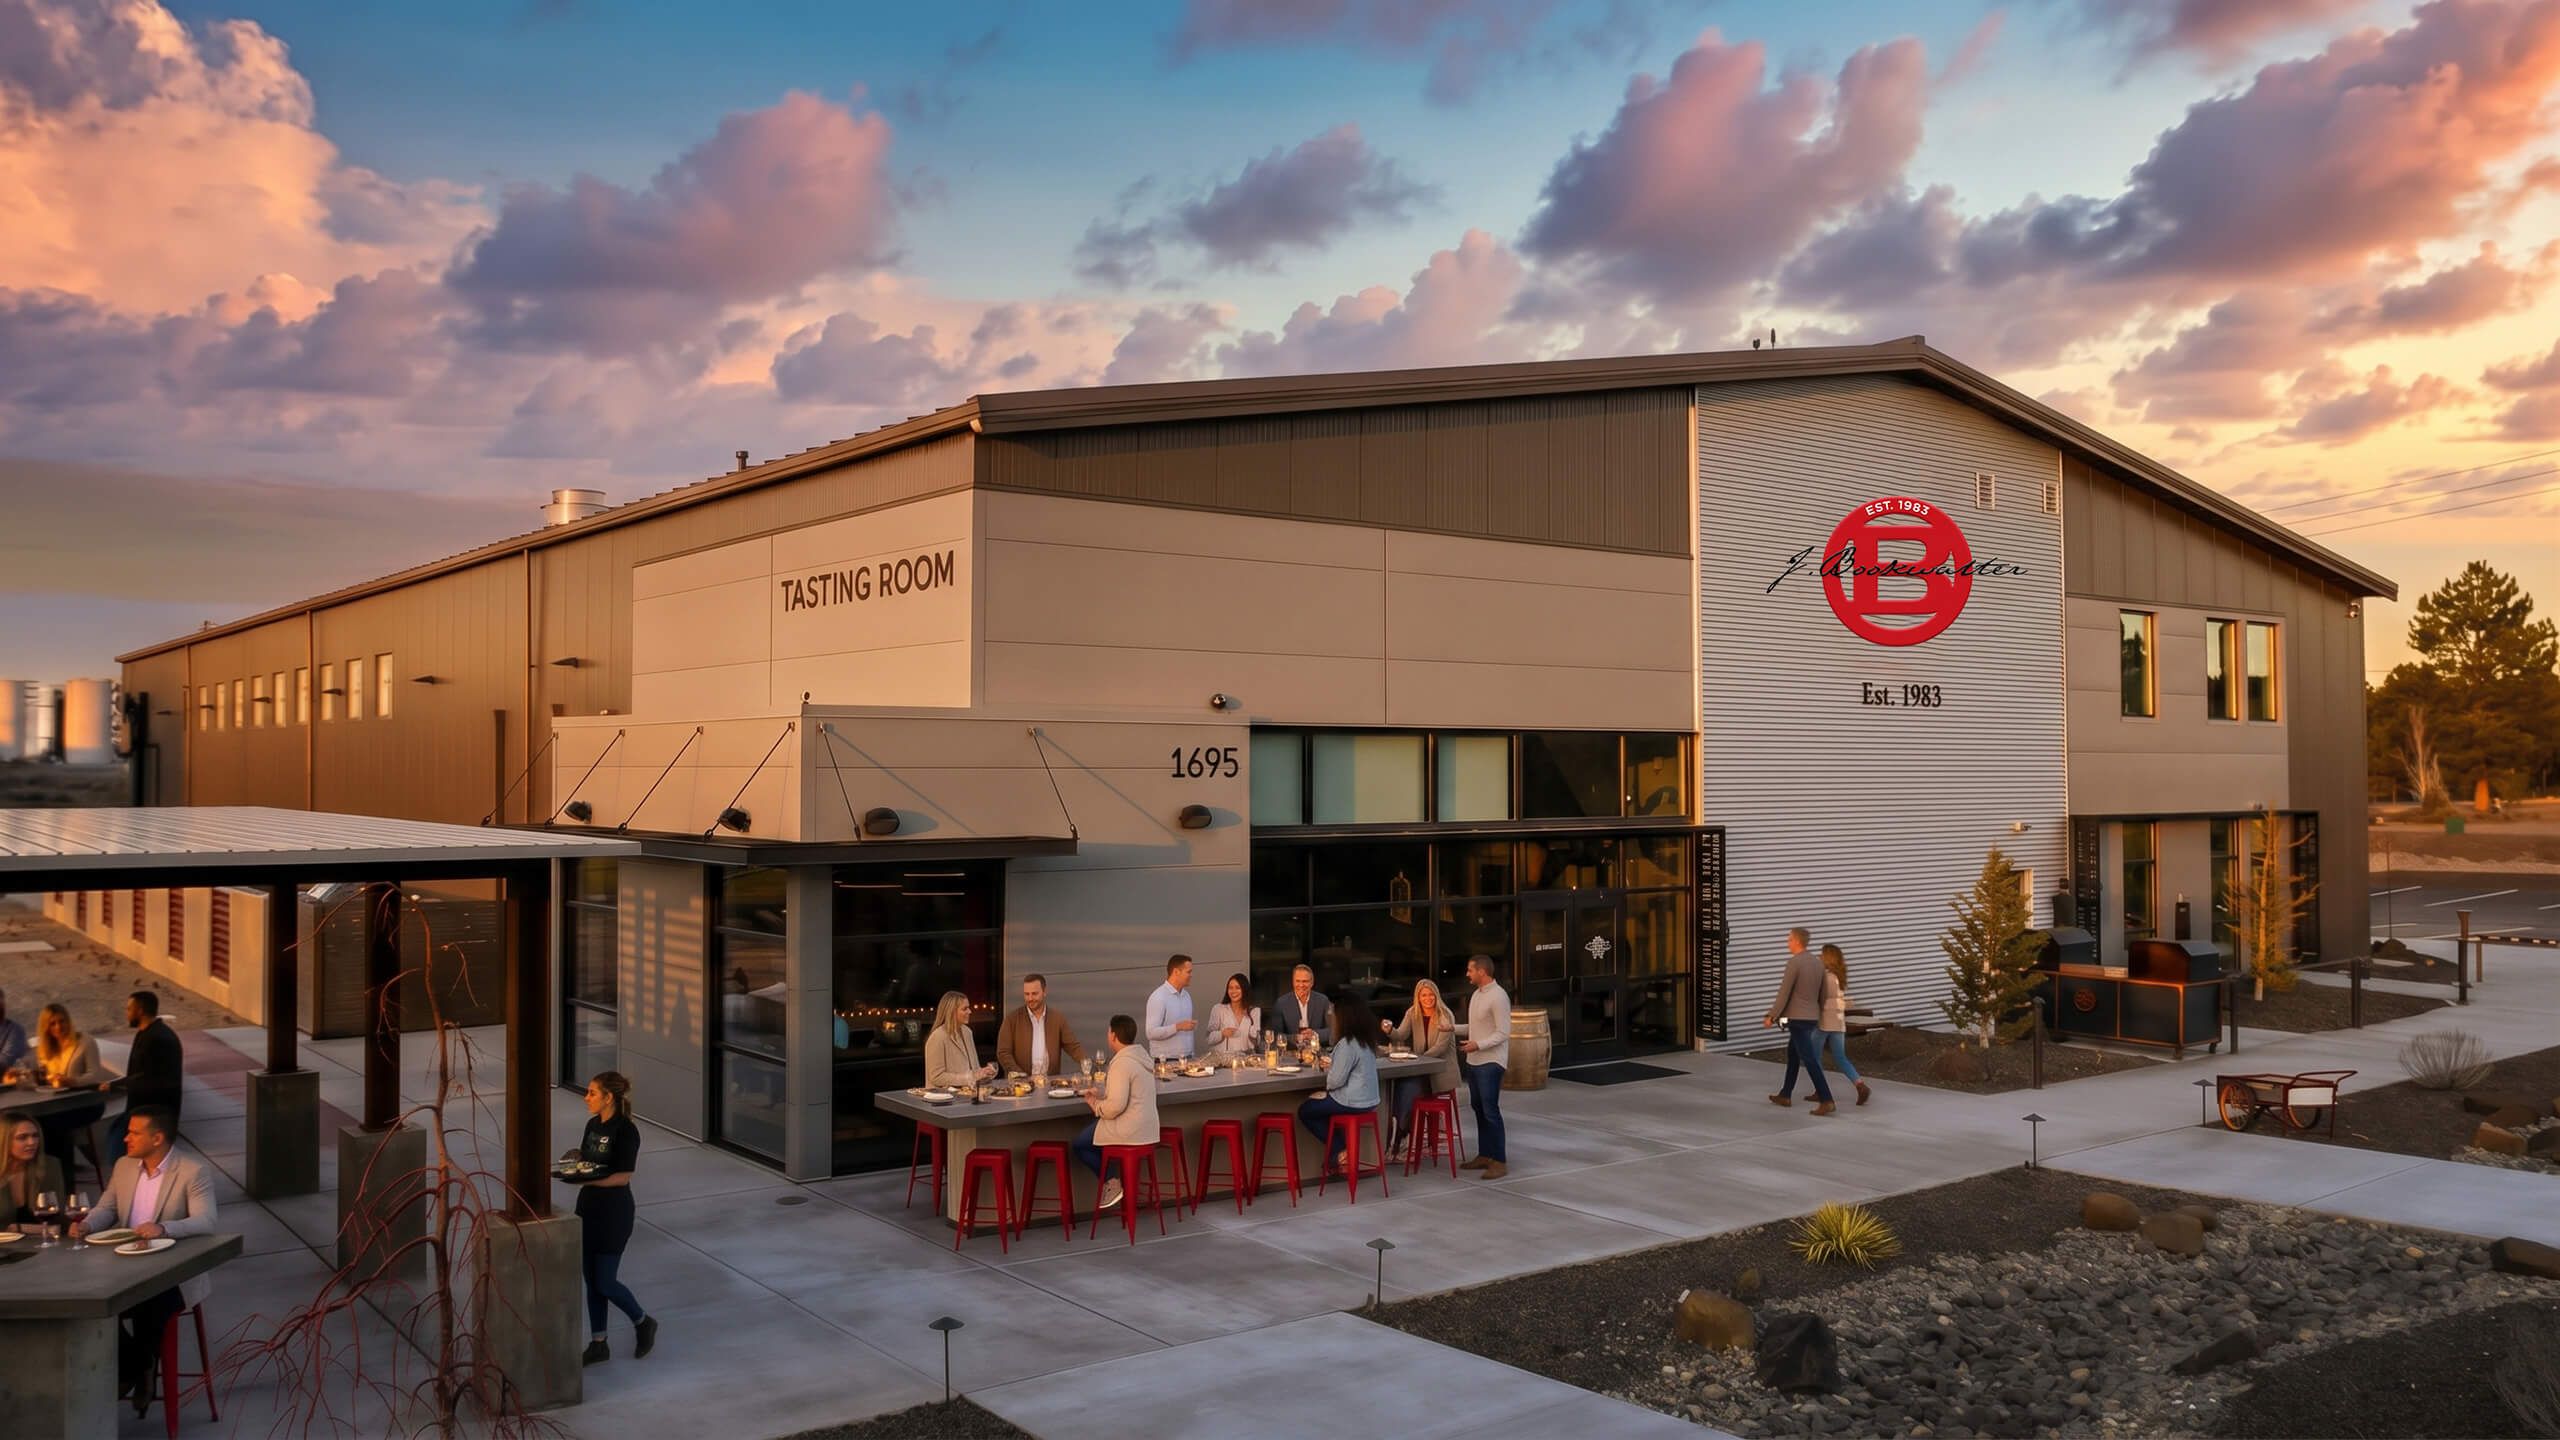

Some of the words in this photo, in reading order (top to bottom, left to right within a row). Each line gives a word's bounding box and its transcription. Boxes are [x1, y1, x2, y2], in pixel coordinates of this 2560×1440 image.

[1865, 500, 1894, 516] EST.
[1898, 500, 1930, 516] 1983
[1819, 546, 2030, 578] Bookwalter
[781, 566, 871, 612] TASTING
[879, 550, 954, 598] ROOM
[1862, 682, 1896, 707] Est.
[1902, 684, 1942, 708] 1983
[1171, 747, 1239, 778] 1695
